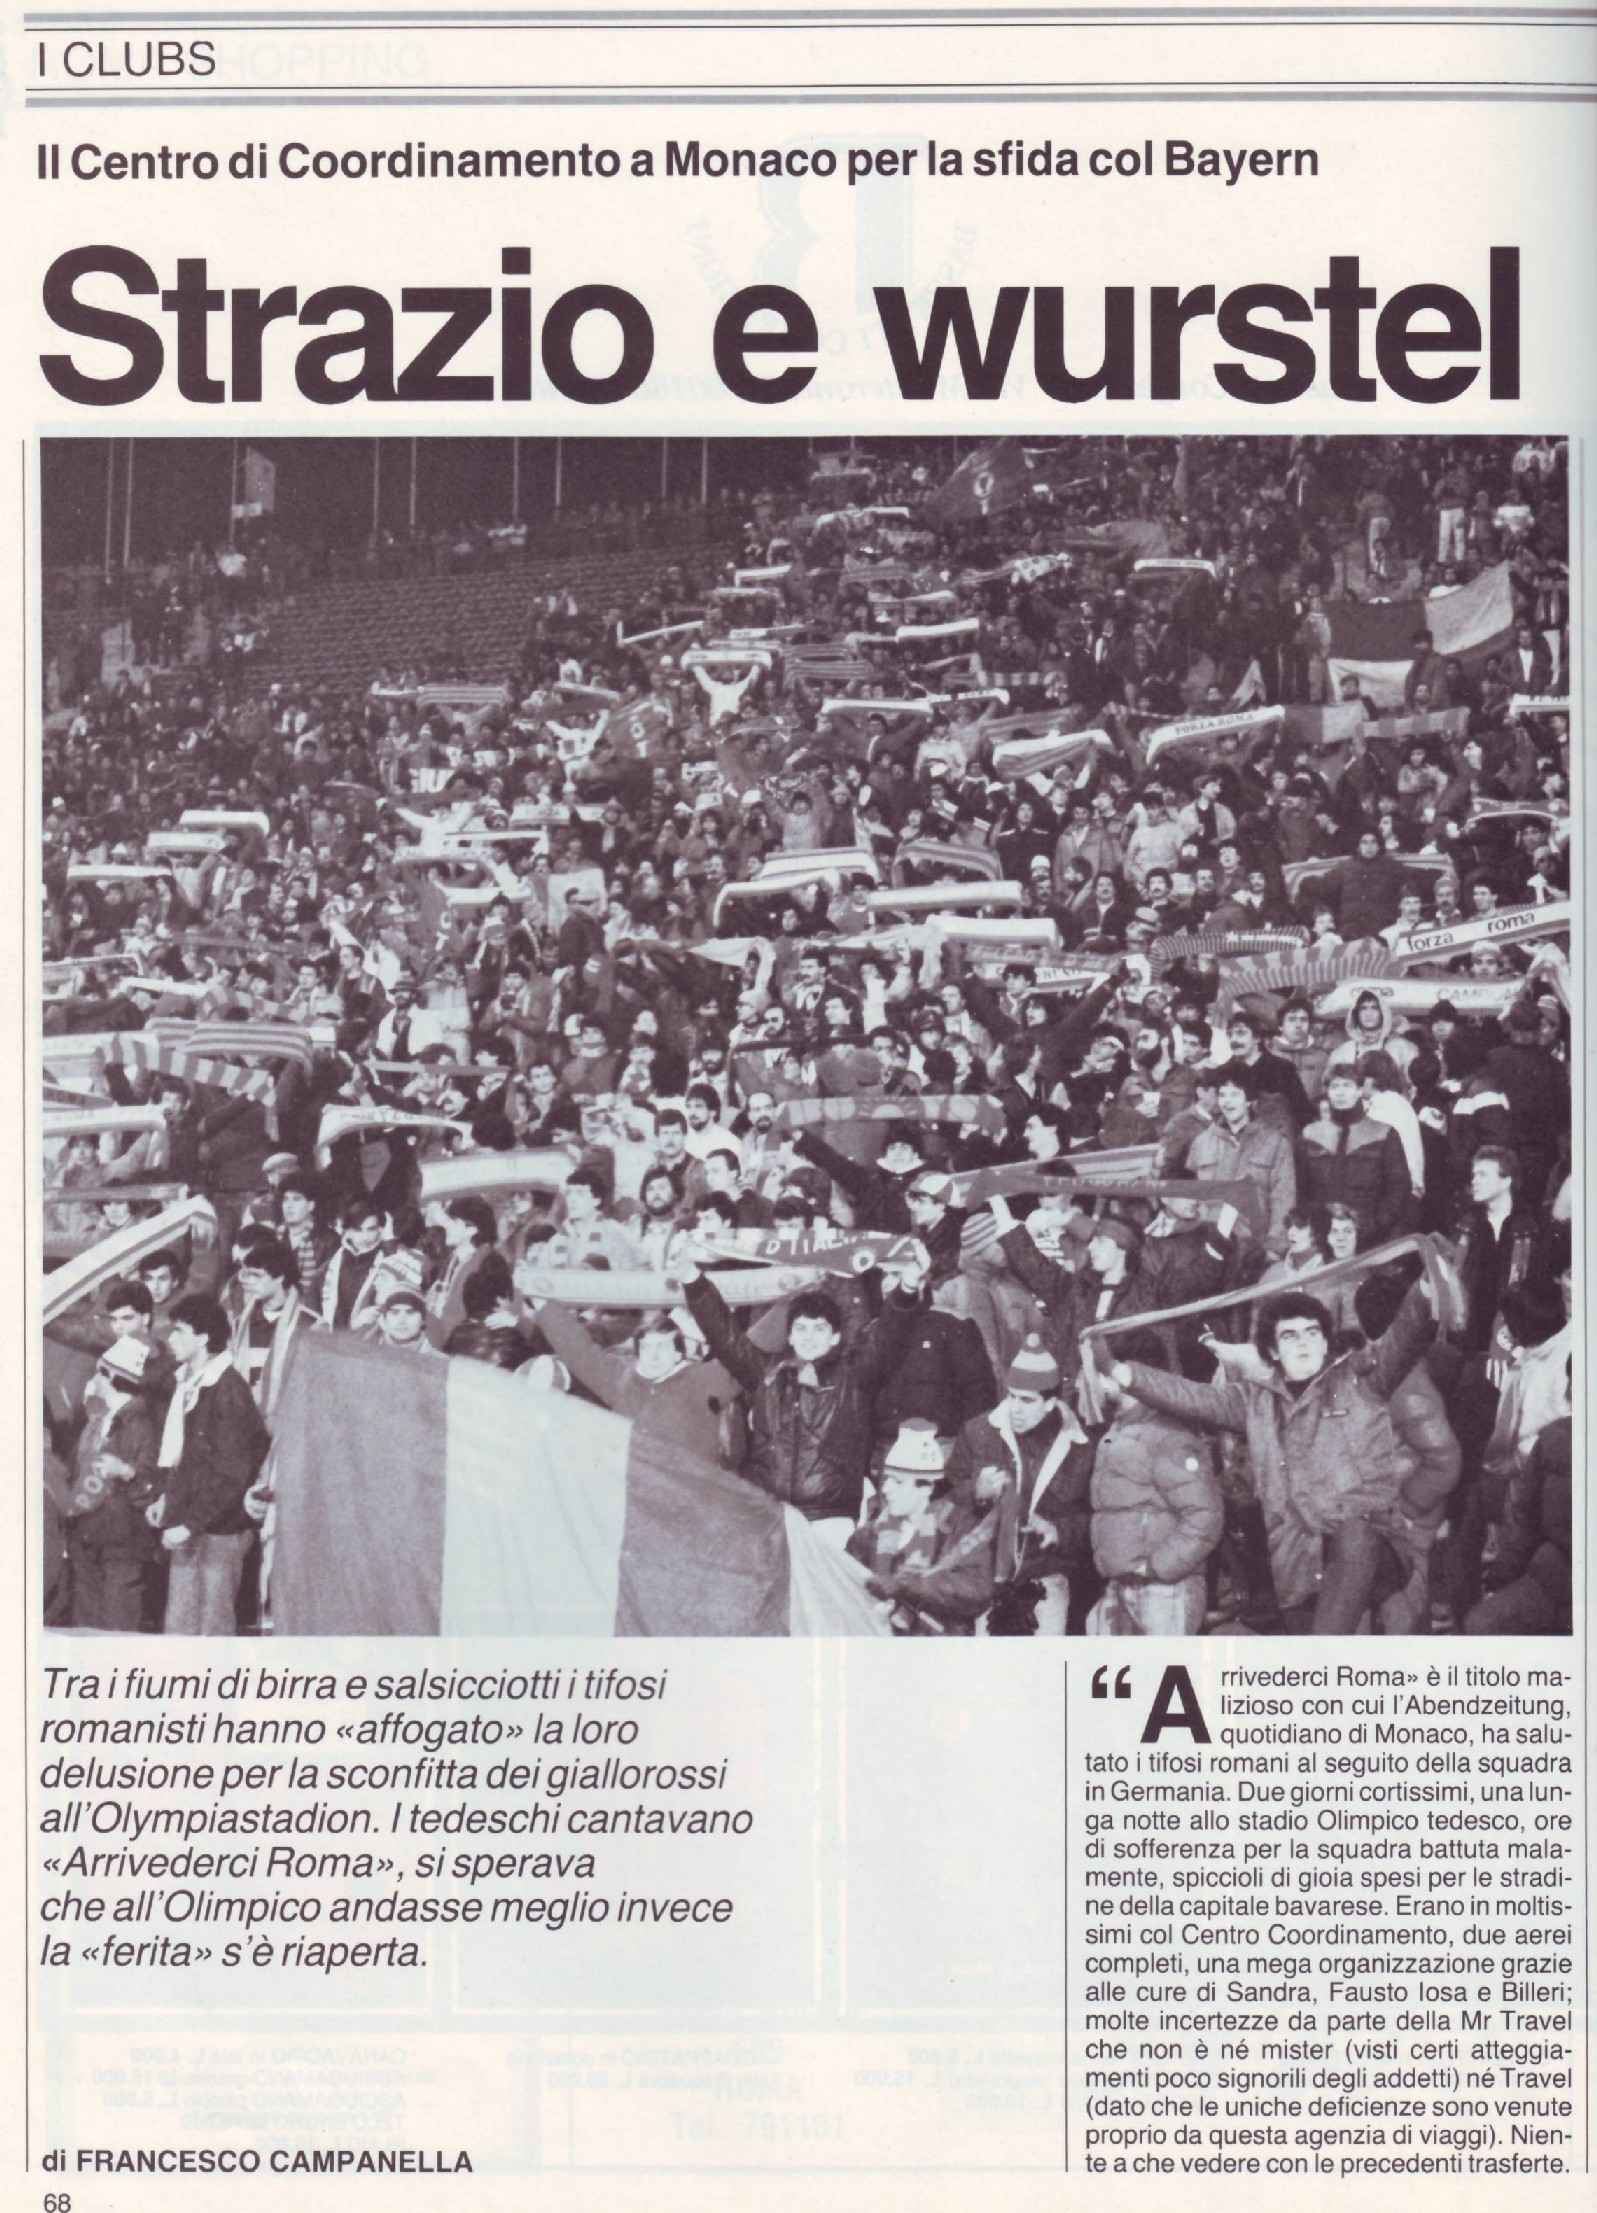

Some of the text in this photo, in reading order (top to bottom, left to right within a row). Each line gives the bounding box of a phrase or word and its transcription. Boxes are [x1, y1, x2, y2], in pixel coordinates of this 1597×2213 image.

[40, 41, 215, 77] I CLUBS
[38, 140, 1317, 186] Il Centro di Coordinamento a Monaco per la sfida col Bayern
[40, 245, 654, 406] Strazio
[713, 285, 818, 404] e
[873, 246, 1520, 404] wurstel
[1407, 911, 1536, 952] forza roma
[44, 1668, 667, 1700] Tra i fiumi di birra e salsicciotti i tifosi
[1427, 1665, 1440, 1686] è
[1449, 1666, 1457, 1686] il
[1466, 1666, 1520, 1686] titolo
[1528, 1671, 1571, 1686] ma-
[1222, 1695, 1293, 1715] lizioso
[1302, 1700, 1343, 1715] con
[1352, 1695, 1383, 1714] cui
[40, 1713, 206, 1744] romanisti
[213, 1712, 325, 1744] hanno
[534, 1713, 563, 1744] la
[573, 1713, 638, 1744] loro
[1221, 1724, 1571, 1749] quotidiano di Monaco, ha salu-
[40, 1757, 728, 1795] delusione per la sconfitta dei giallorossi
[1085, 1752, 1572, 1778] tato i tifosi romani al seguito della squadra
[392, 1802, 402, 1833] I
[410, 1803, 561, 1833] tedeschi
[568, 1805, 752, 1834] cantavano
[1086, 1810, 1572, 1835] ga notte allo stadio Olimpico tedesco, ore
[416, 1847, 446, 1878] si
[452, 1854, 594, 1884] sperava
[1086, 1867, 1572, 1892] mente, spiccioli di gioia spesi per le stradi-
[41, 1890, 105, 1921] che
[330, 1891, 482, 1922] andasse
[491, 1891, 609, 1929] meglio
[618, 1892, 733, 1922] invece
[1086, 1924, 1571, 1948] simi col Centro Coordinamento, due aerei
[41, 1934, 70, 1966] la
[282, 1936, 426, 1973] riaperta.
[1086, 1981, 1571, 2005] alle cure di Sandra, Fausto Iosa e Billeri;
[1086, 2039, 1572, 2064] che non è né mister (visti certi atteggia-
[1087, 2096, 1572, 2120] (dato che le uniche deficienze sono venute
[1086, 2125, 1572, 2150] proprio da questa agenzia di viaggi). Nien-
[42, 2149, 472, 2172] di FRANCESCO CAMPANELLA
[1086, 2153, 1569, 2178] te a che vedere con le precedenti trasferte.
[44, 2193, 71, 2213] 68
